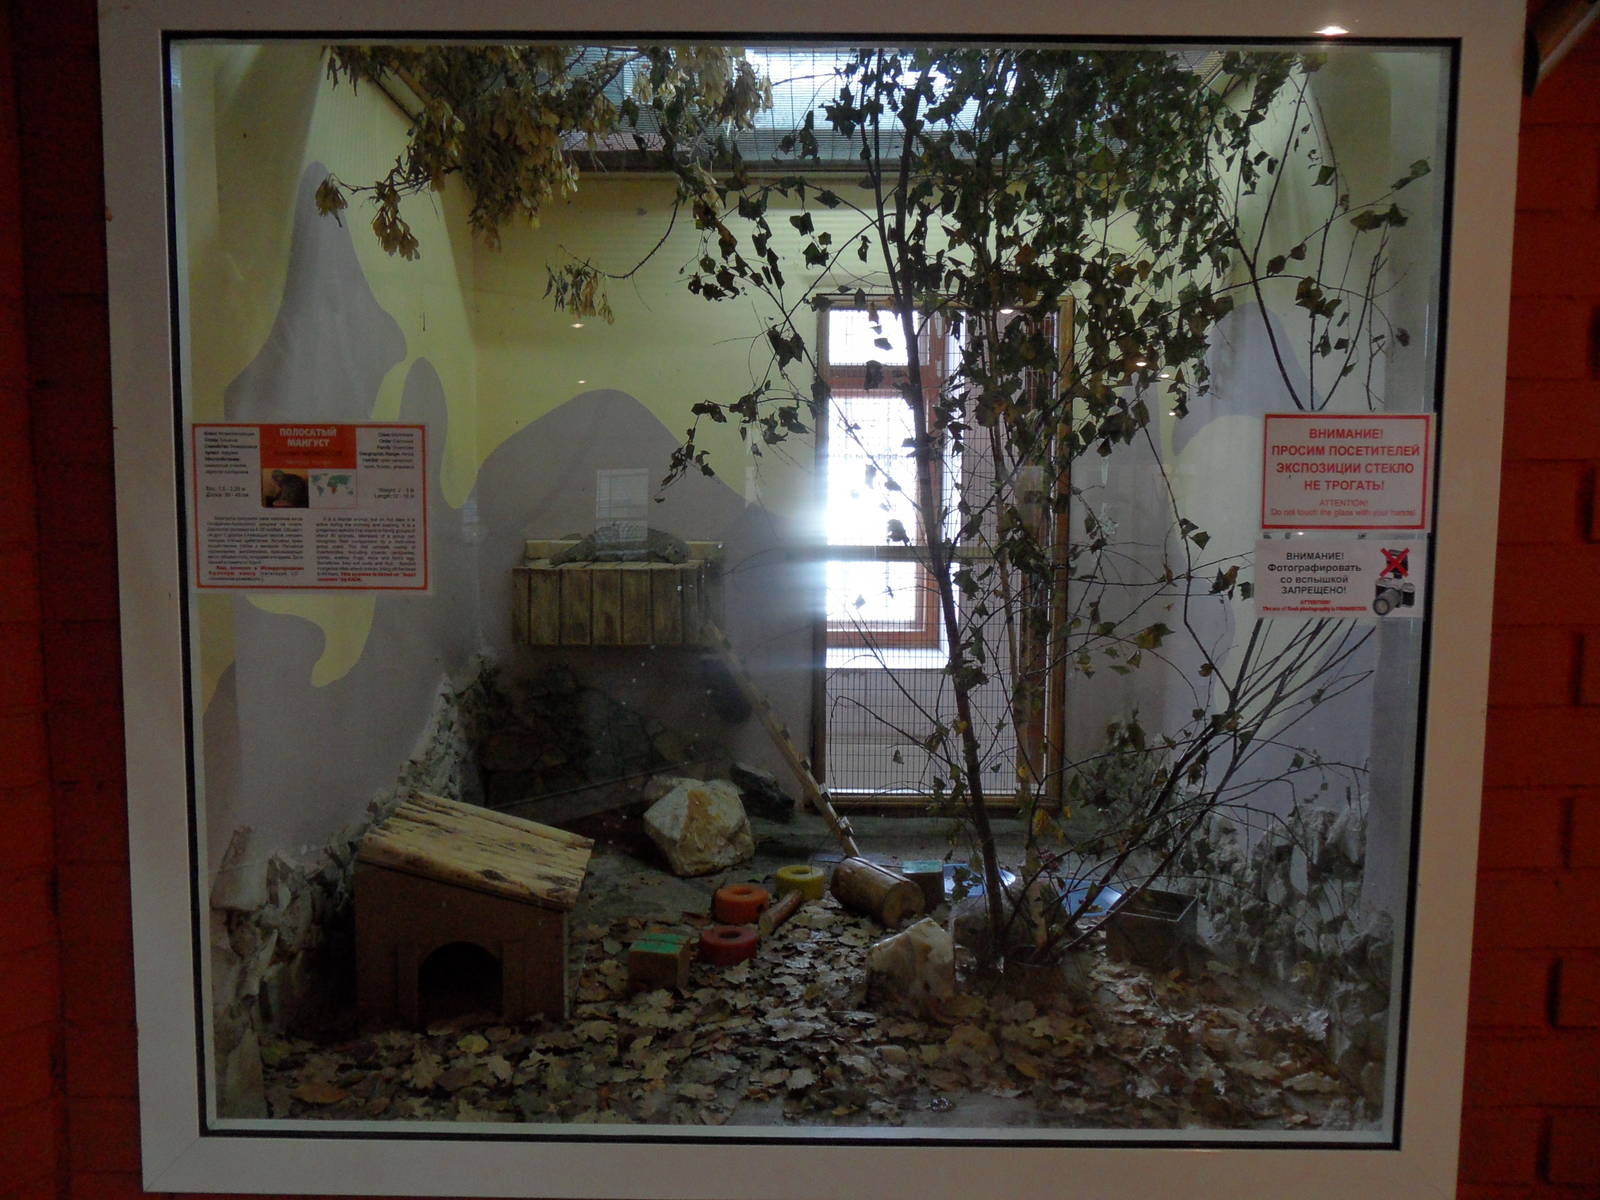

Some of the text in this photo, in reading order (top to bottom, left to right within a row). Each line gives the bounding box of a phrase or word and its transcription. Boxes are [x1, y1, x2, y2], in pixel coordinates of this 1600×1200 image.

[279, 426, 337, 437] ПОЛОСАТЫЙ
[1309, 428, 1384, 439] ВНИМАНИЕ!
[287, 438, 330, 447] МАНГУСТ
[1272, 444, 1420, 457] ПРОСИМ ПОСЕТИТЕЛЕЙ
[1276, 462, 1415, 475] ЭКСПОЗИЦИИ СТЕКЛО
[1304, 480, 1385, 491] НЕ ТРОГАТЬ!
[1286, 552, 1345, 560] ВНИМАНИЕ!
[1267, 564, 1362, 573] Фотографировать
[1295, 575, 1349, 584] вспышкой
[1281, 586, 1346, 595] ЗАПРЕЩЕНО!
